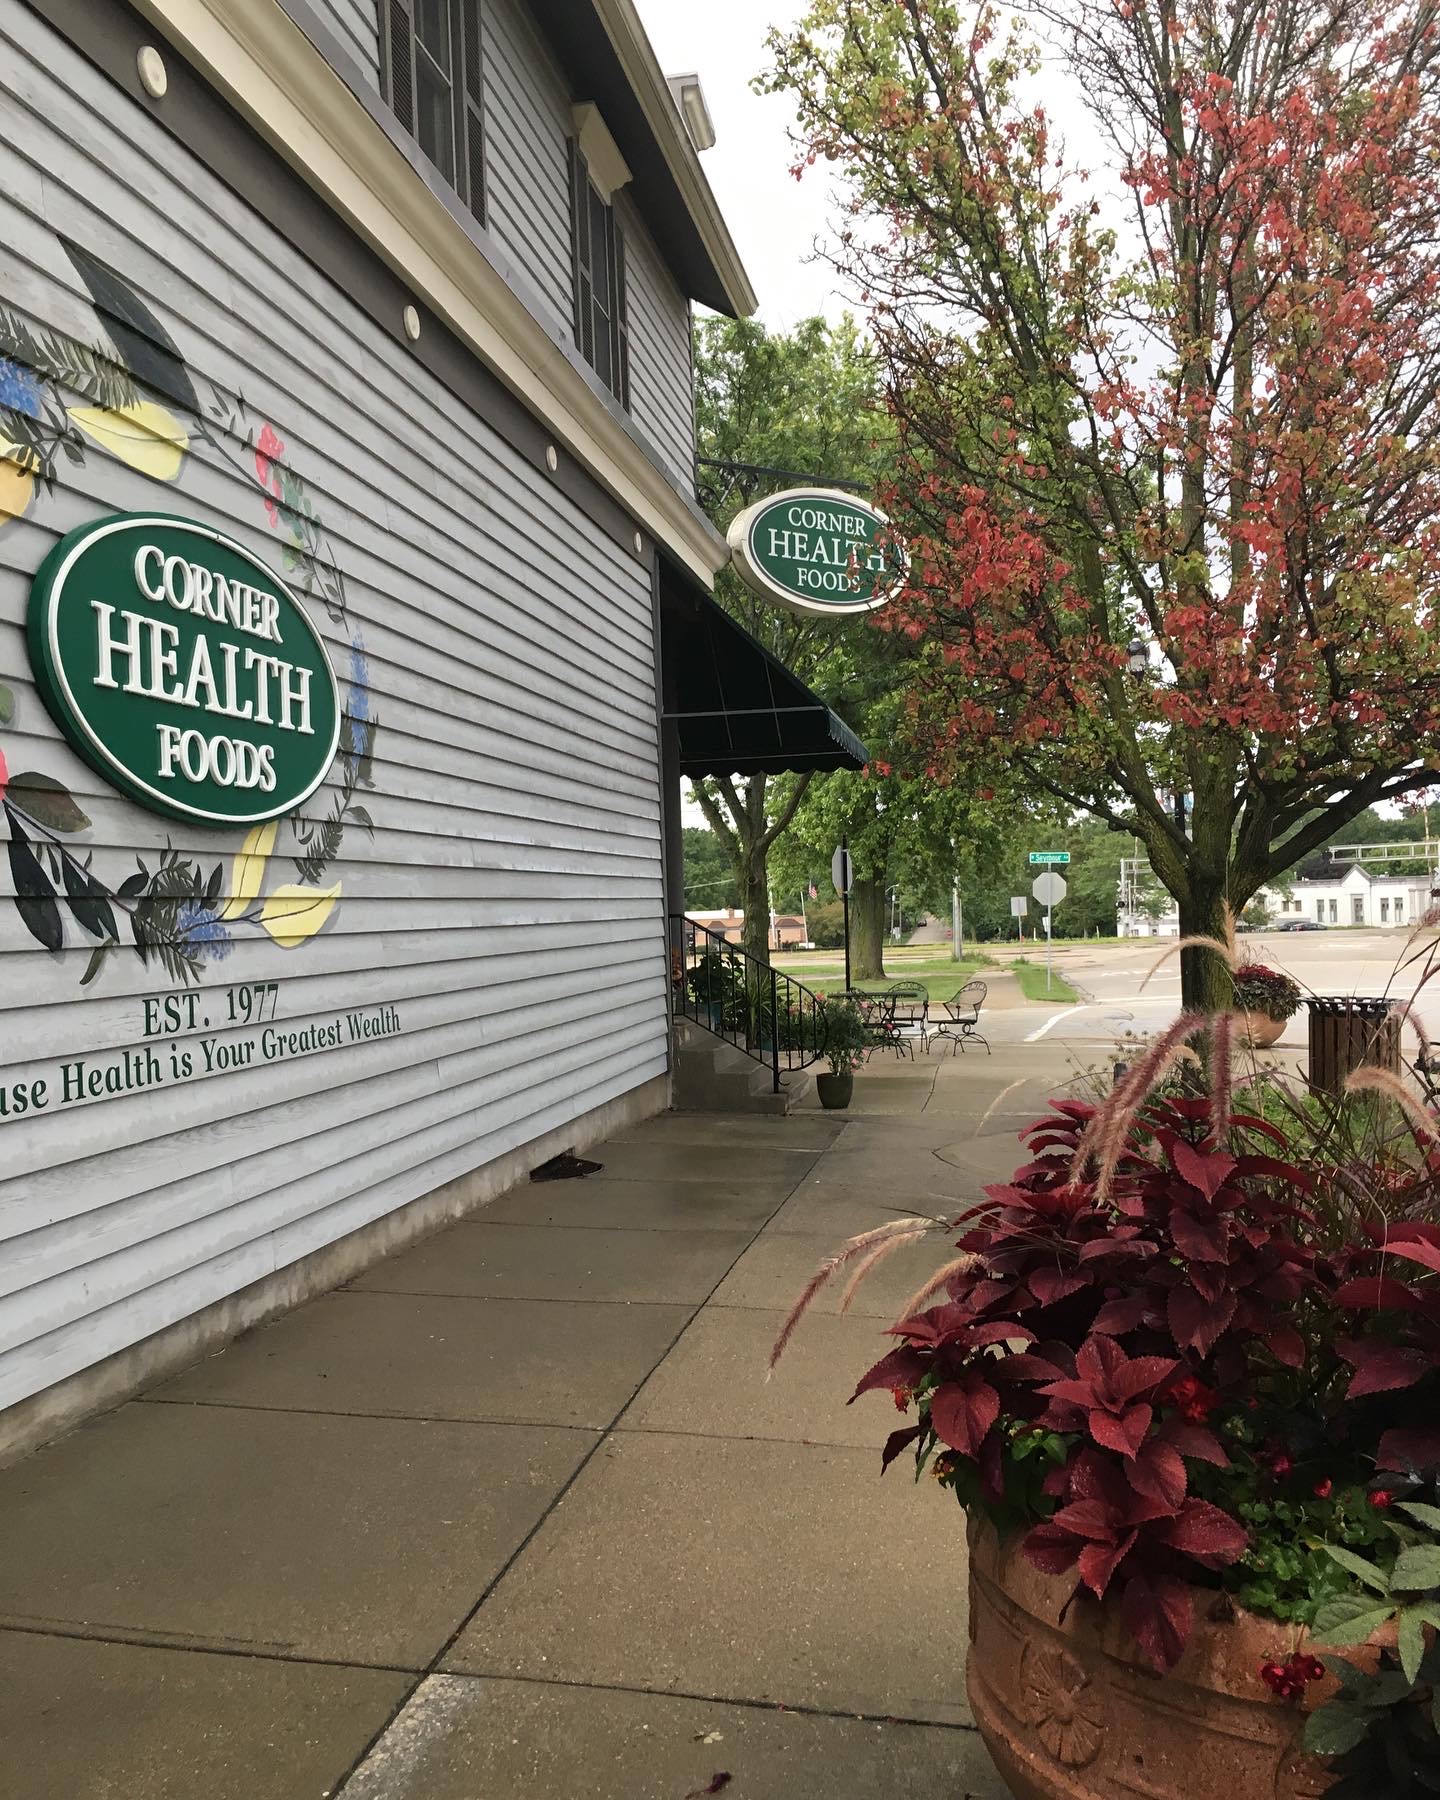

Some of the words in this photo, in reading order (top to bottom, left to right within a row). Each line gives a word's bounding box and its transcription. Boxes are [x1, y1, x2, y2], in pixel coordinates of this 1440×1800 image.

[768, 528, 887, 572] HEALTH
[788, 507, 867, 537] CORNER
[134, 545, 283, 644] CORNER
[797, 567, 861, 593] FOODS
[91, 600, 315, 735] HEALTH
[156, 723, 277, 792] FOODS
[142, 993, 210, 1037] EST.
[226, 983, 280, 1023] 1977
[60, 1047, 163, 1104] Health
[171, 1043, 193, 1080] is
[200, 1038, 255, 1073] Your
[262, 1021, 344, 1060] Greatest
[346, 1005, 401, 1042] Wealth
